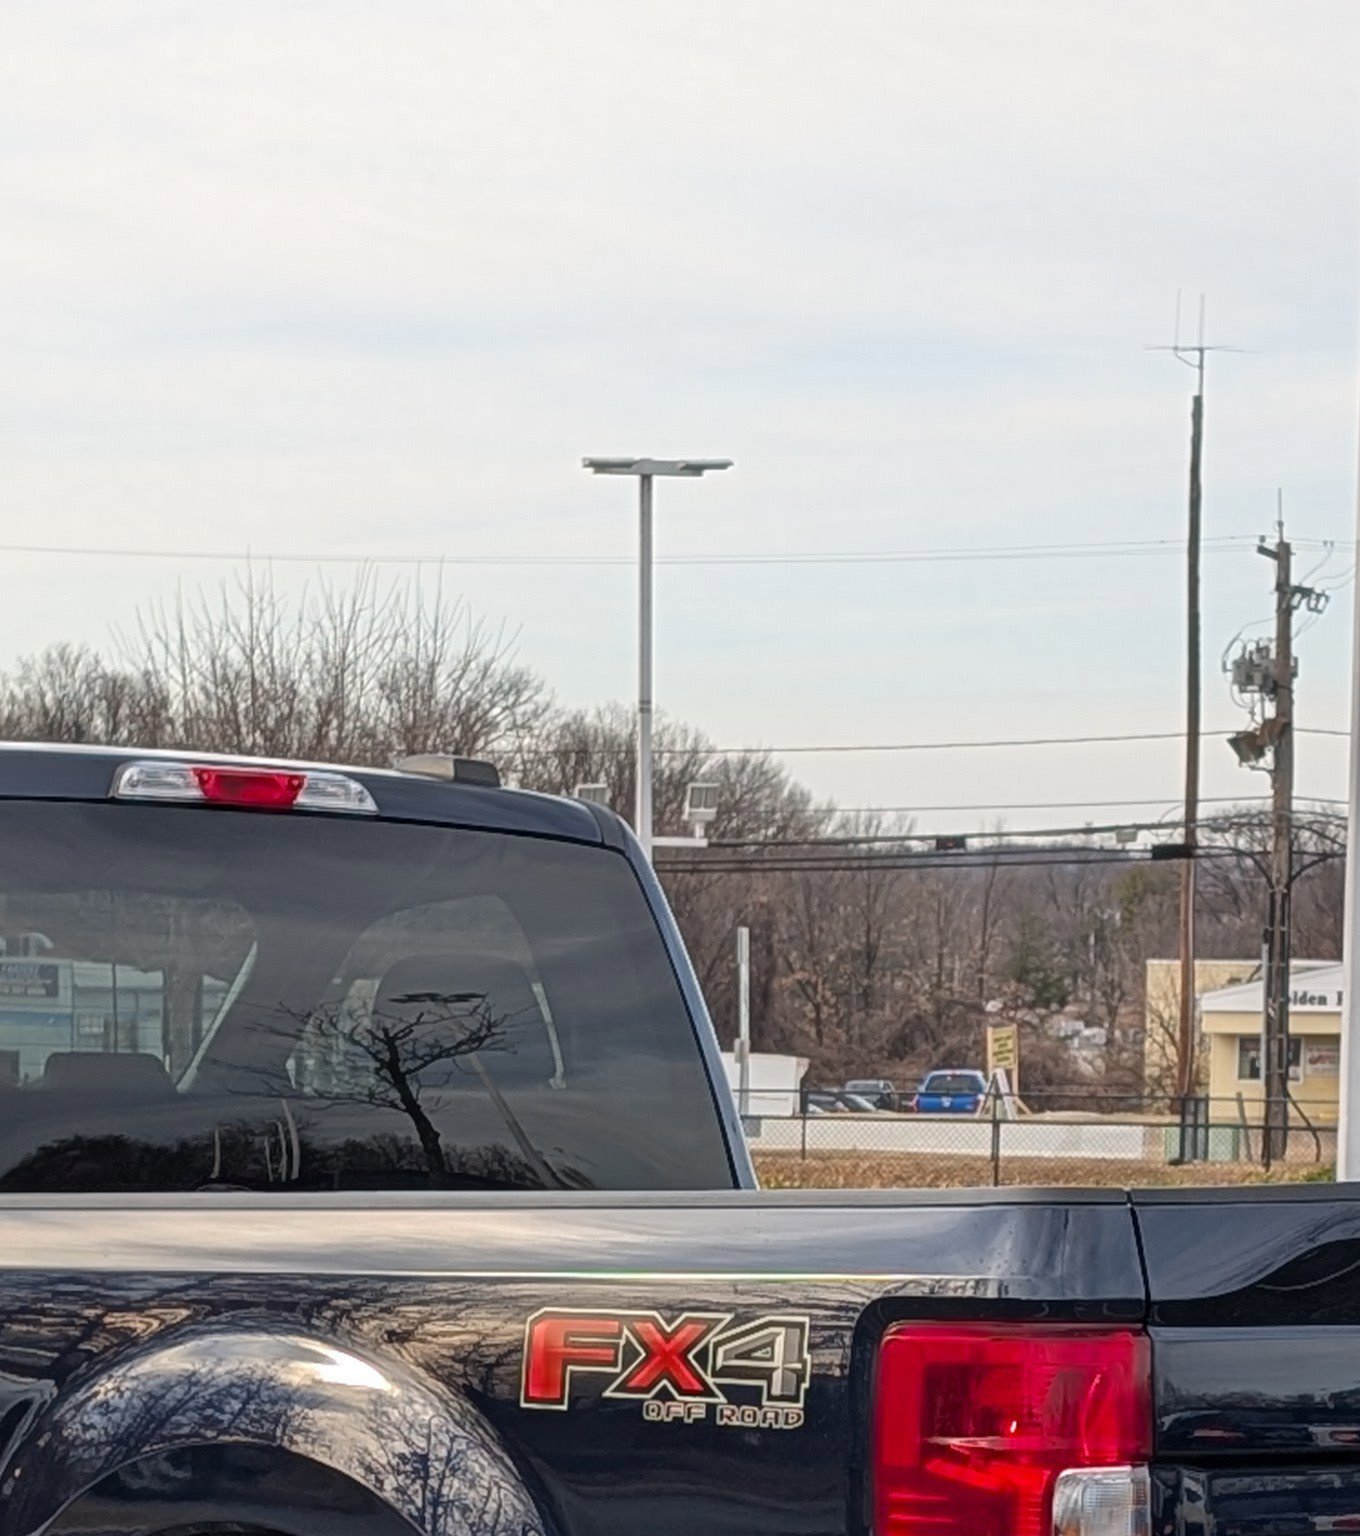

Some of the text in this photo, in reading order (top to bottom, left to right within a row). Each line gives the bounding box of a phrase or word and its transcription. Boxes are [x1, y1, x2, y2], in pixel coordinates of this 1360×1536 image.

[520, 1307, 811, 1411] FX4
[643, 1401, 804, 1429] OFF ROAD
